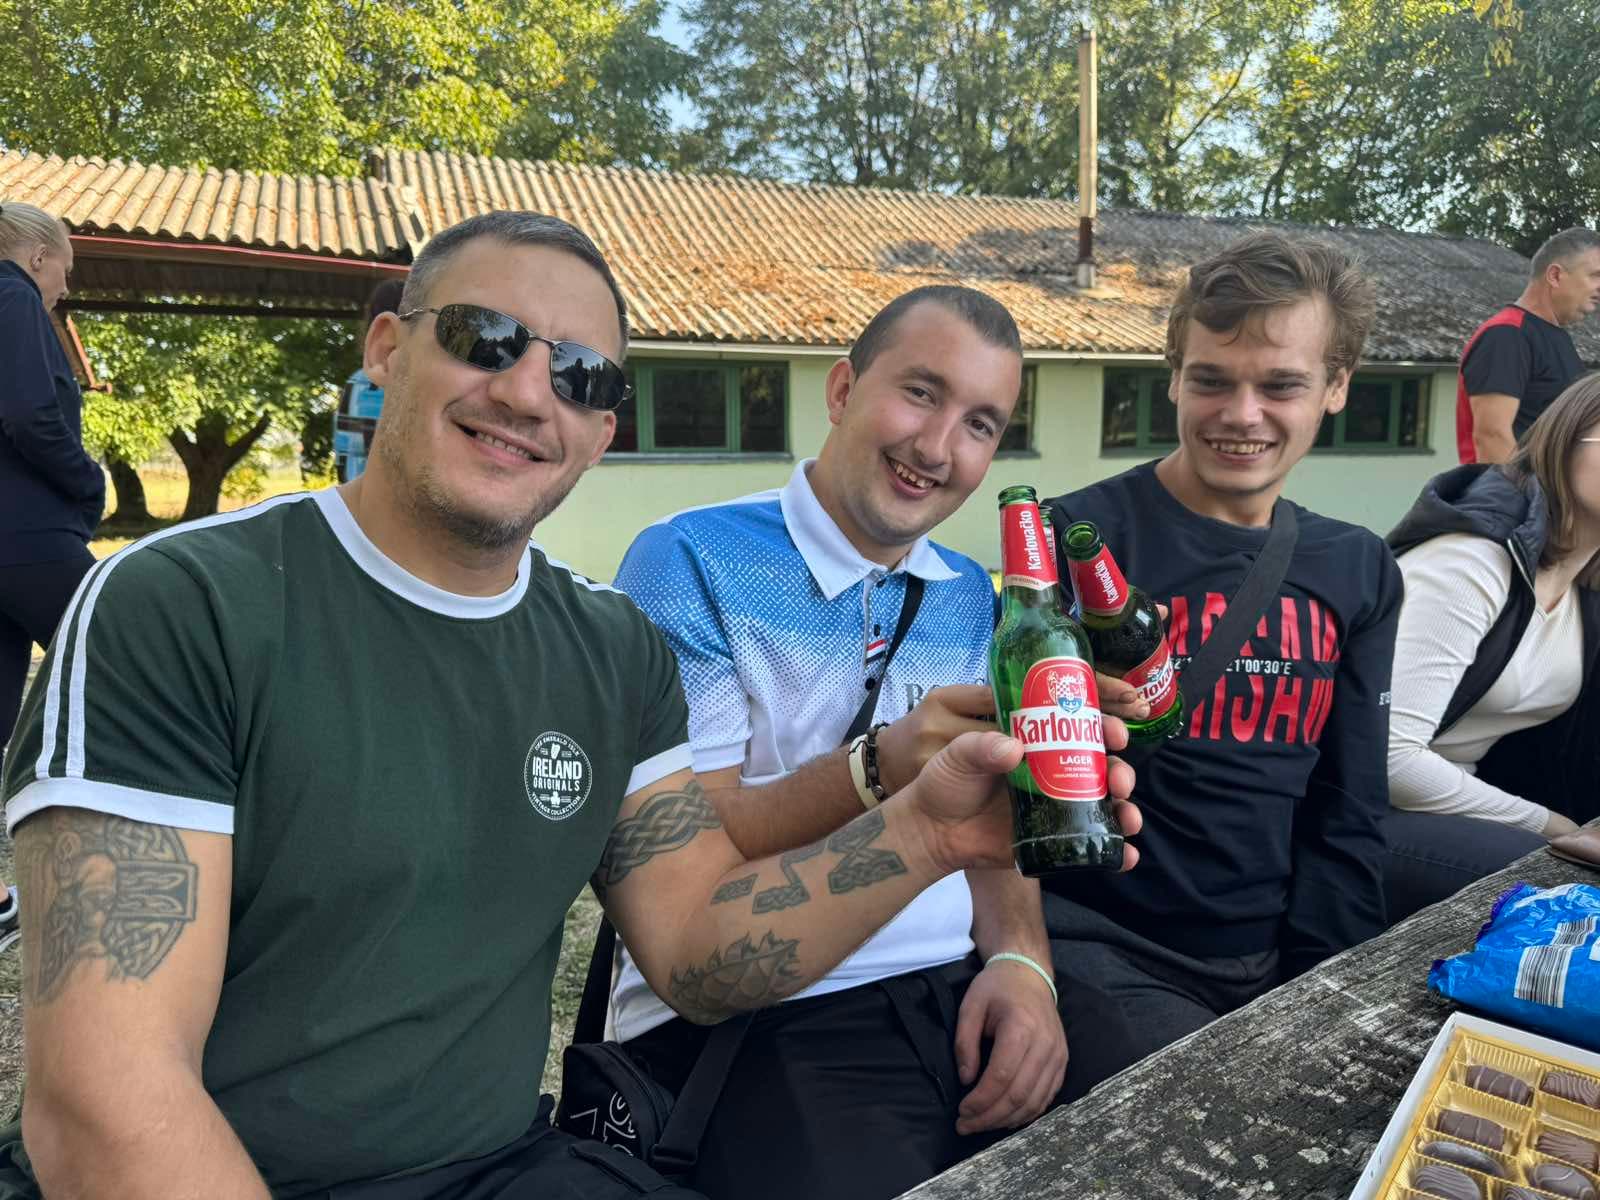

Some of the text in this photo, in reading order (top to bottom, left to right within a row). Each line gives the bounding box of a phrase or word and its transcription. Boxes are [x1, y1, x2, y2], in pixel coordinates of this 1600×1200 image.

[1020, 510, 1042, 570] Karlovačko
[1012, 711, 1105, 746] Karlovač
[532, 755, 582, 780] IRELAND
[1059, 755, 1093, 766] LAGER
[533, 776, 581, 792] ORIGINALS
[550, 795, 582, 816] COLLECTION
